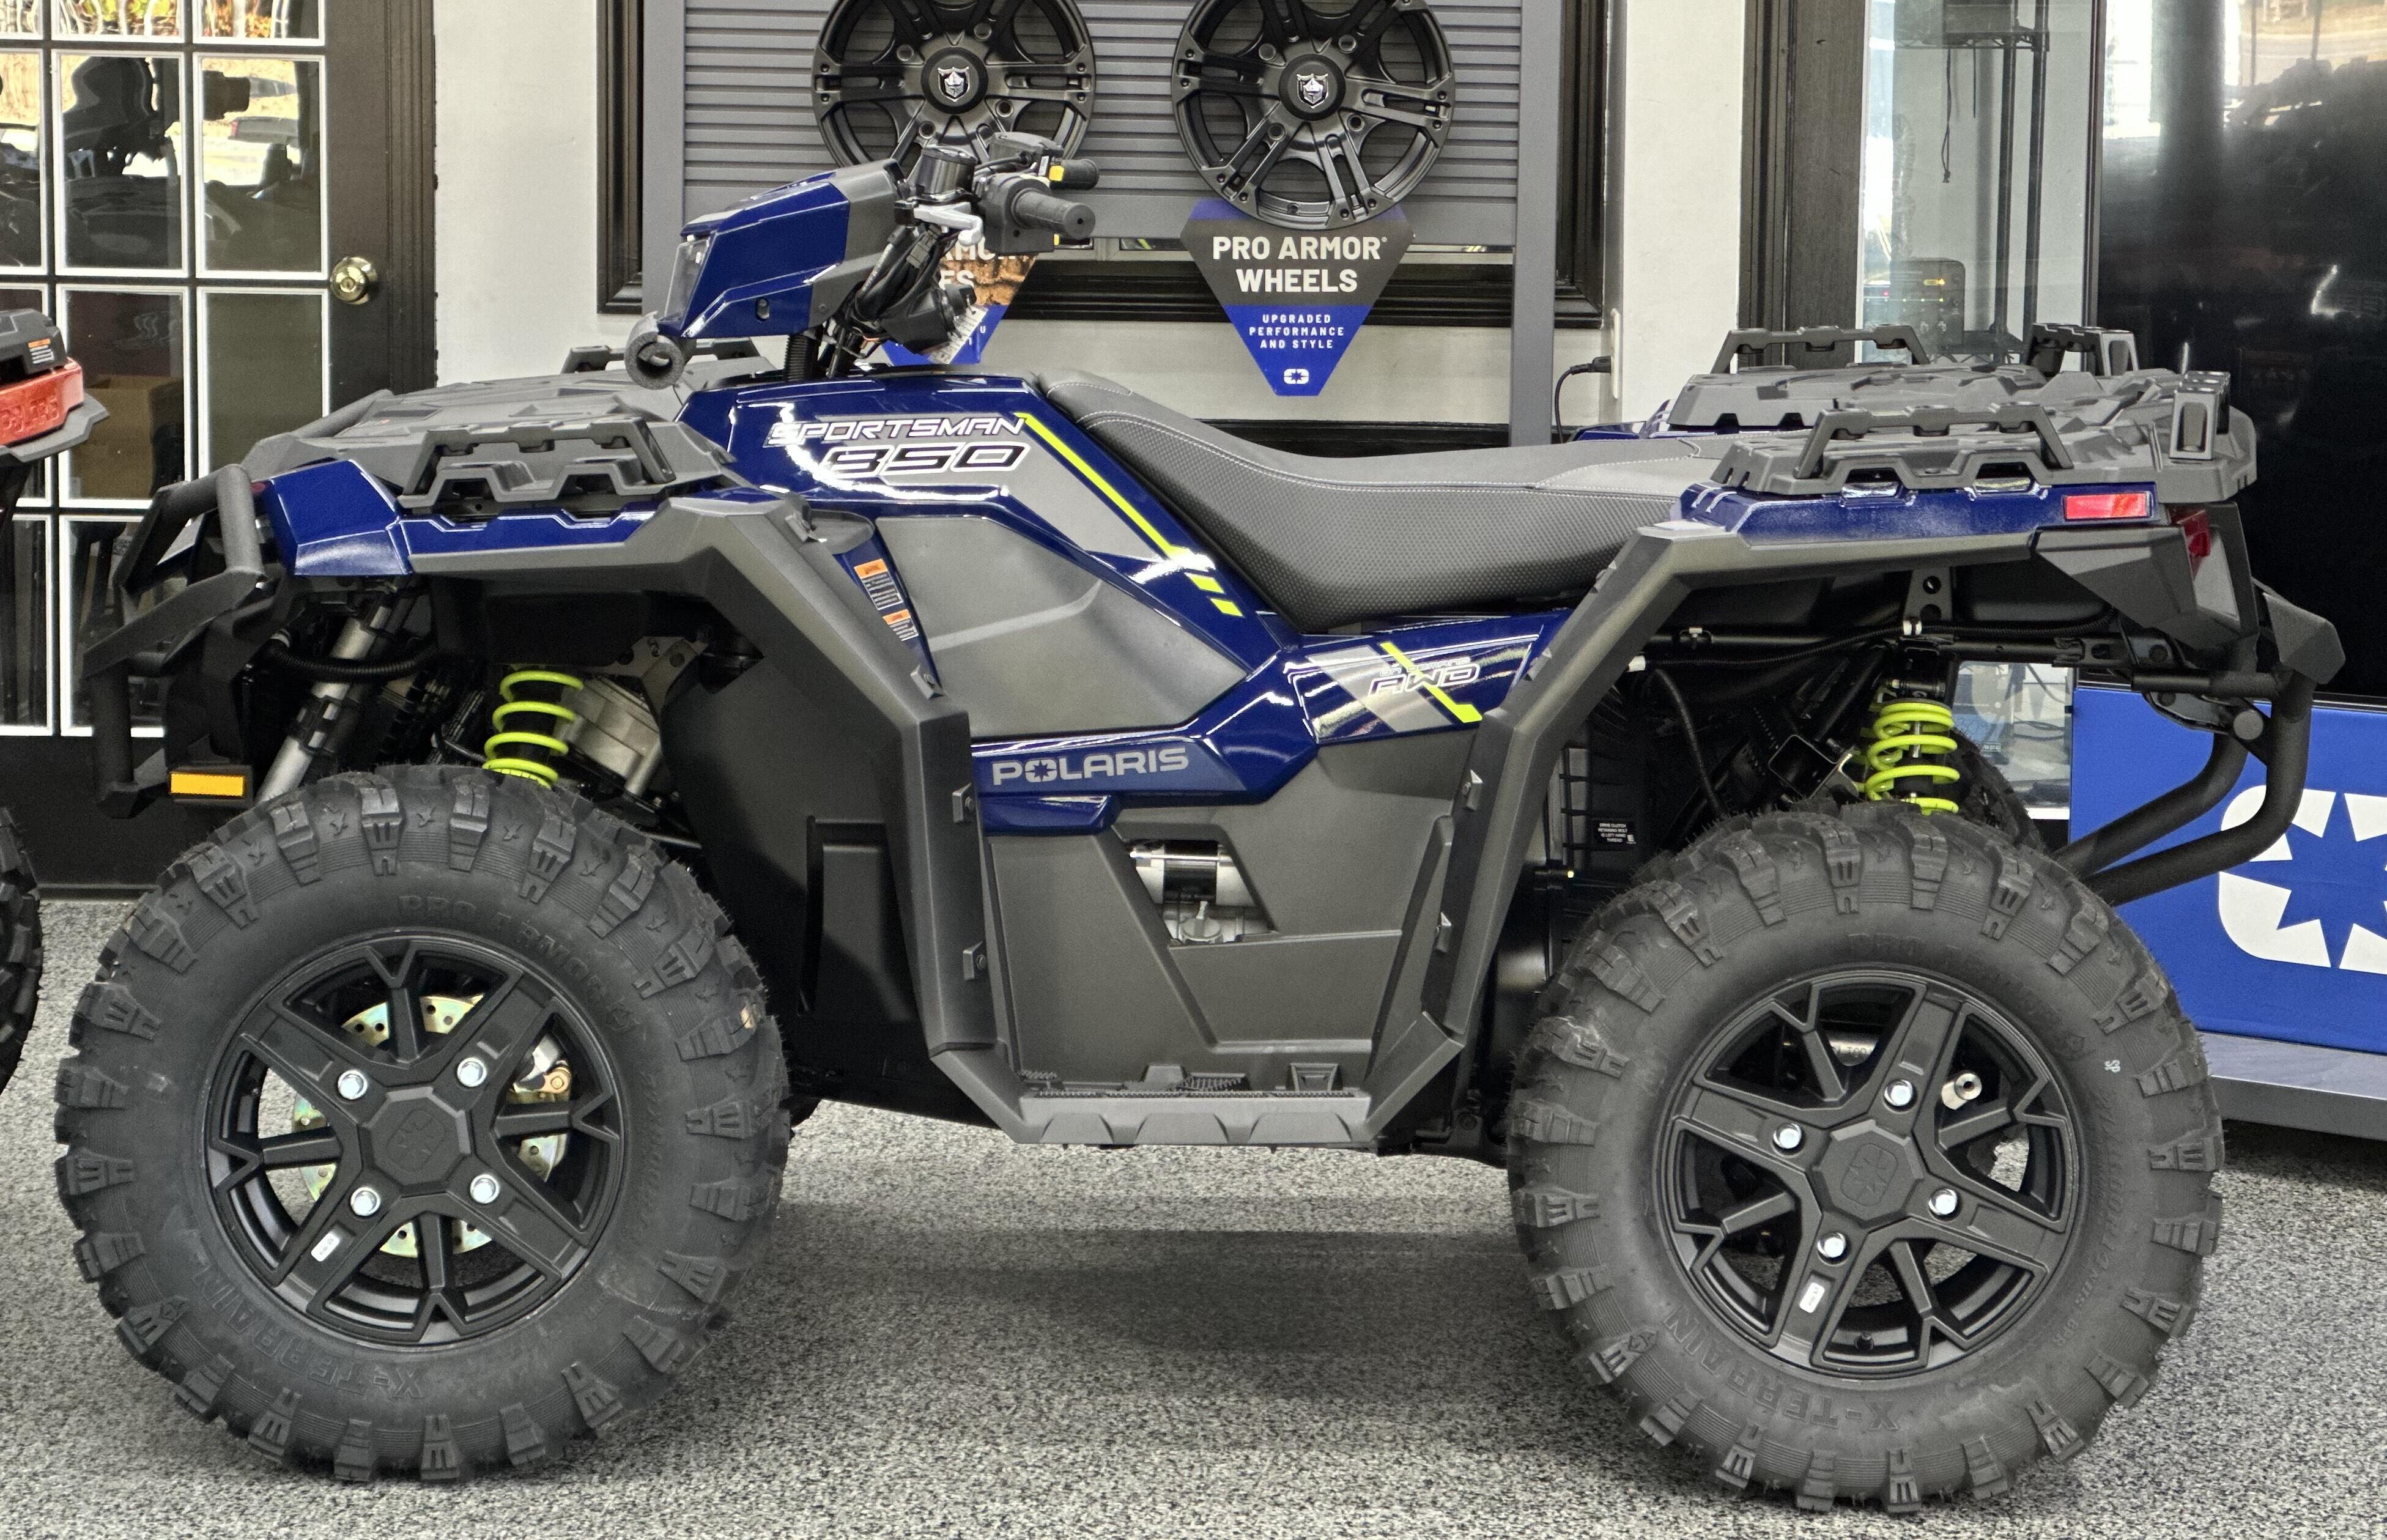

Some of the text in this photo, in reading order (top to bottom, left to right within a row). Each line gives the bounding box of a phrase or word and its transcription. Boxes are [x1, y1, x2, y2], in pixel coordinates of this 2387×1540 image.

[1213, 236, 1270, 260] PRO
[1235, 268, 1358, 292] WHEELS
[1249, 327, 1345, 336] PERFORMANCE
[1262, 314, 1331, 324] UPGRADED
[1260, 339, 1333, 349] AND STYLE
[768, 417, 1026, 445] SPORTSMAN
[1367, 663, 1480, 697] AWD
[992, 747, 1190, 787] POLARIS
[190, 1259, 426, 1404] X-TERRAIN
[1657, 1302, 1900, 1432] X-TERRAIN
